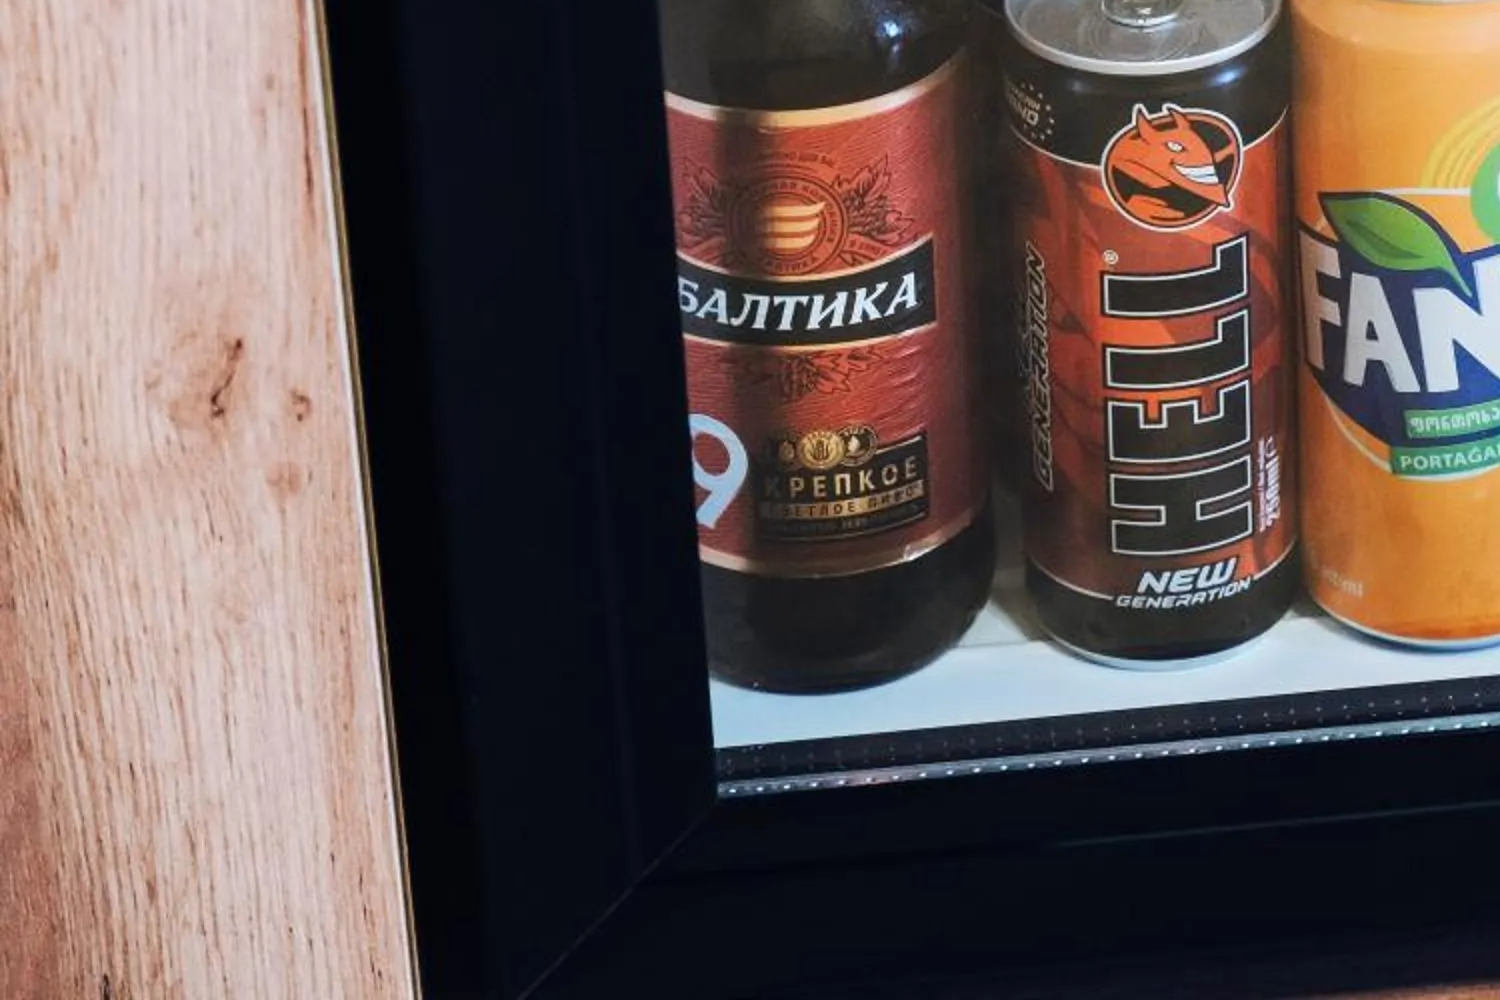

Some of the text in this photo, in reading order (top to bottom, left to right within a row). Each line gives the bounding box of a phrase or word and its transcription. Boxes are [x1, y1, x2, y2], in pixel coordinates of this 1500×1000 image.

[677, 272, 921, 332] БАЛТИКА
[1102, 235, 1249, 557] HELL
[689, 413, 749, 529] 9
[1116, 577, 1252, 609] GENERATION
[1137, 557, 1239, 594] NEW
